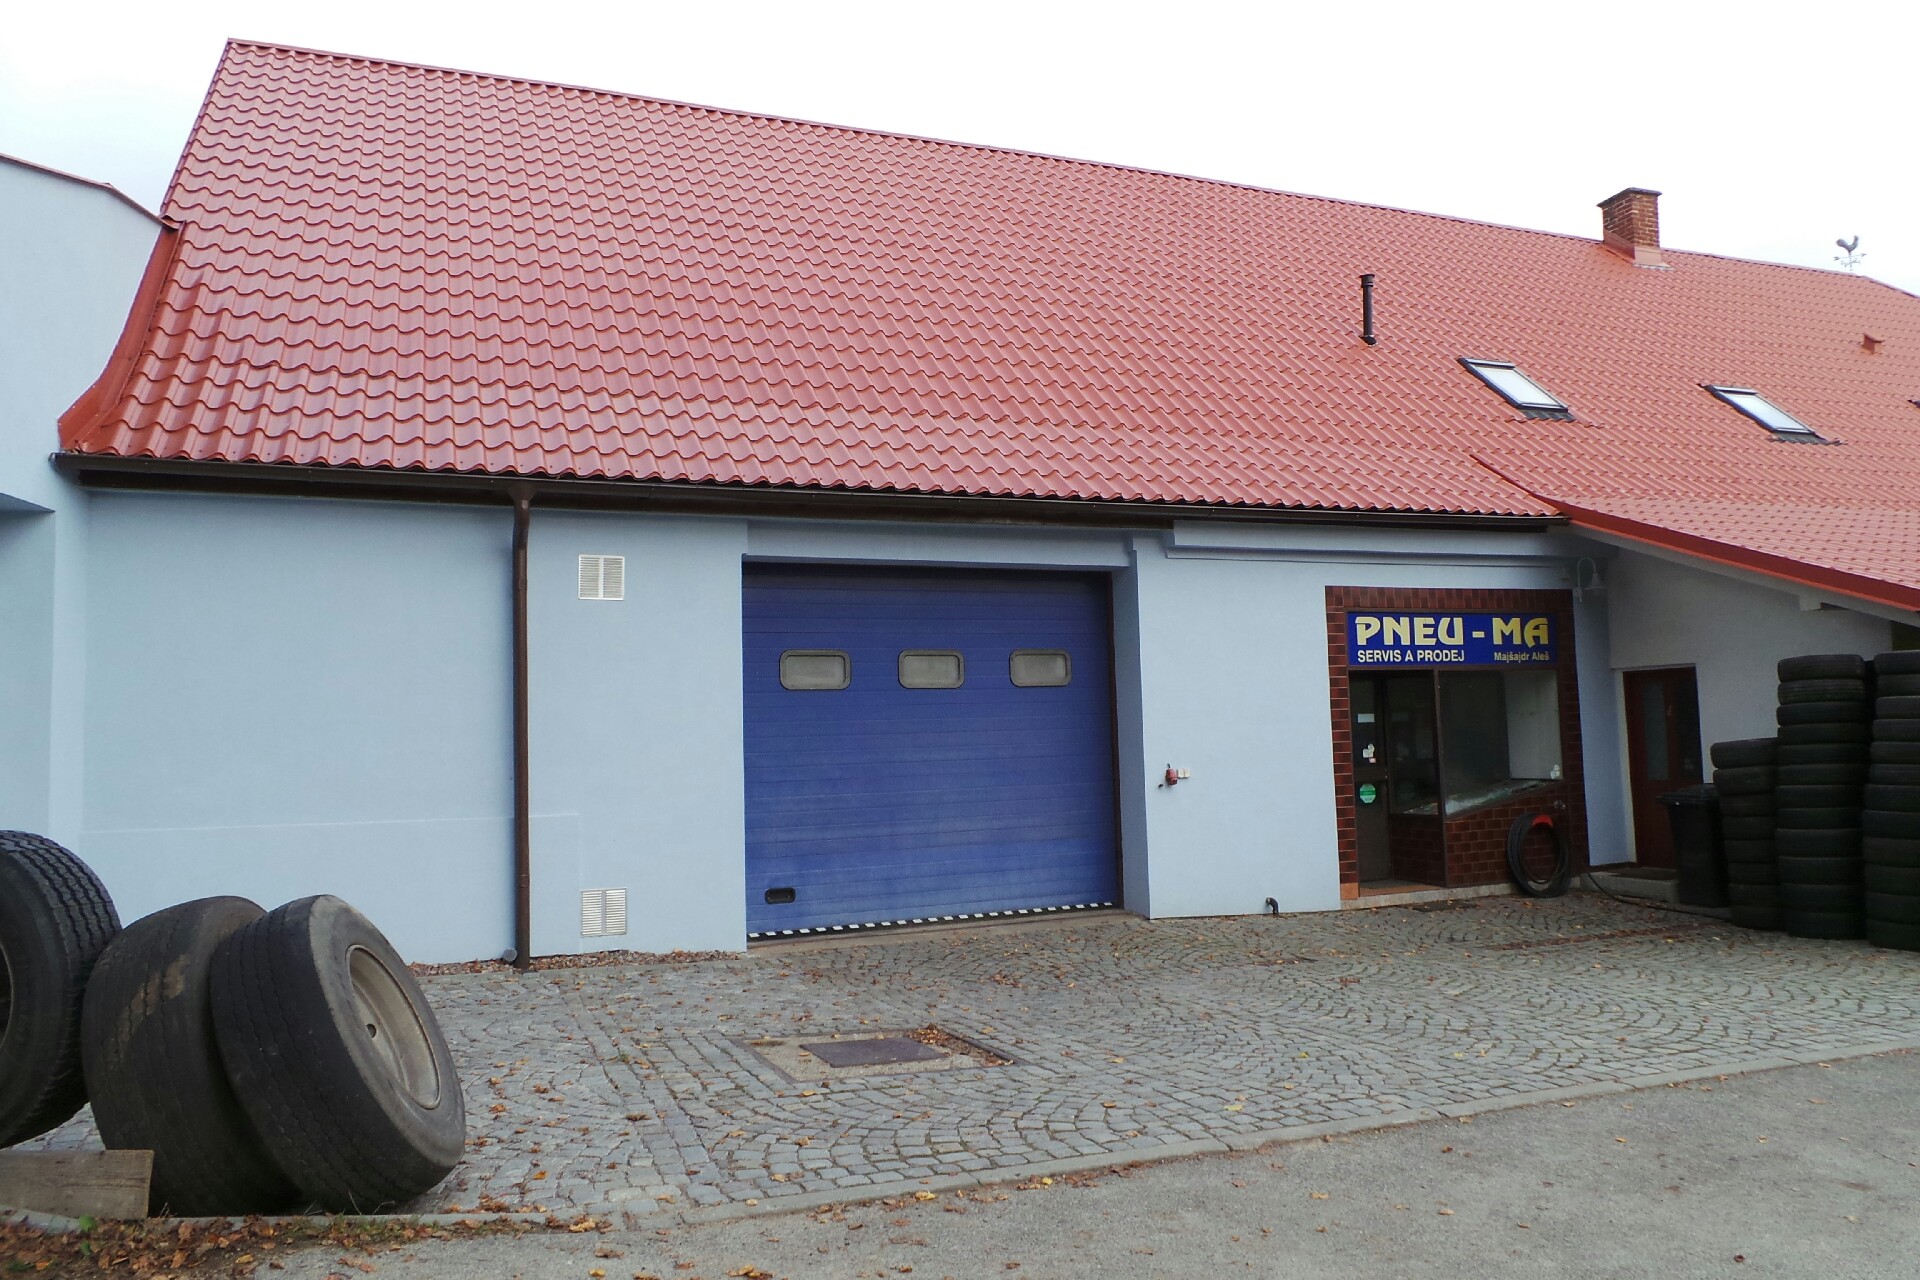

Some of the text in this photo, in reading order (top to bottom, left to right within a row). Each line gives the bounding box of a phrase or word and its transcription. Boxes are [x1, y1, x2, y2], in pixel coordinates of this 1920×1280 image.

[1355, 616, 1464, 645] PNEU
[1492, 617, 1548, 648] MA
[1357, 649, 1465, 662] SERVIS A PRODEJ
[1494, 651, 1550, 663] Majšajdr Aleš
